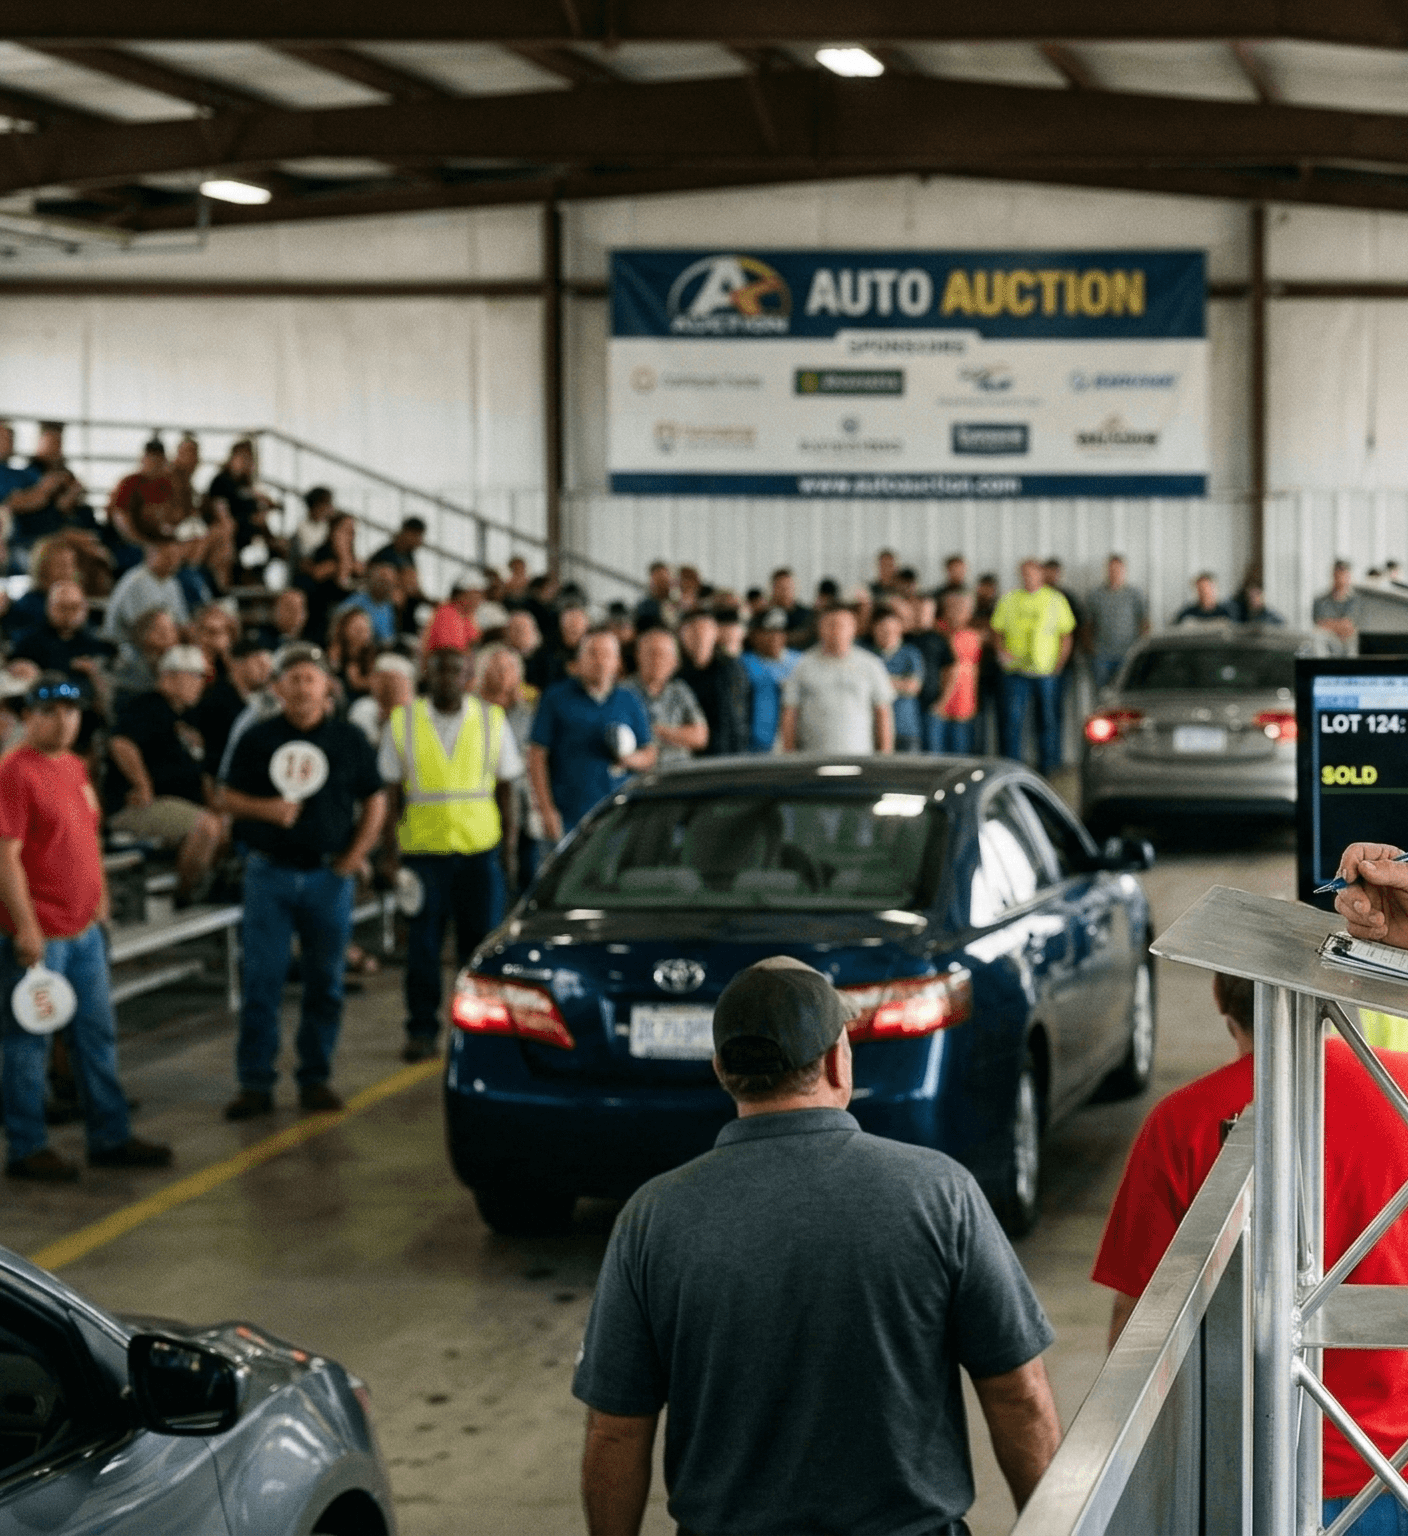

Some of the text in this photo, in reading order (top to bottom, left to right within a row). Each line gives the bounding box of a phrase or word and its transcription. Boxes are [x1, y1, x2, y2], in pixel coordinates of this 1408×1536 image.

[805, 268, 1146, 318] AUTO AUCTION
[1321, 714, 1407, 734] LOT 124:
[1321, 765, 1378, 786] SOLD
